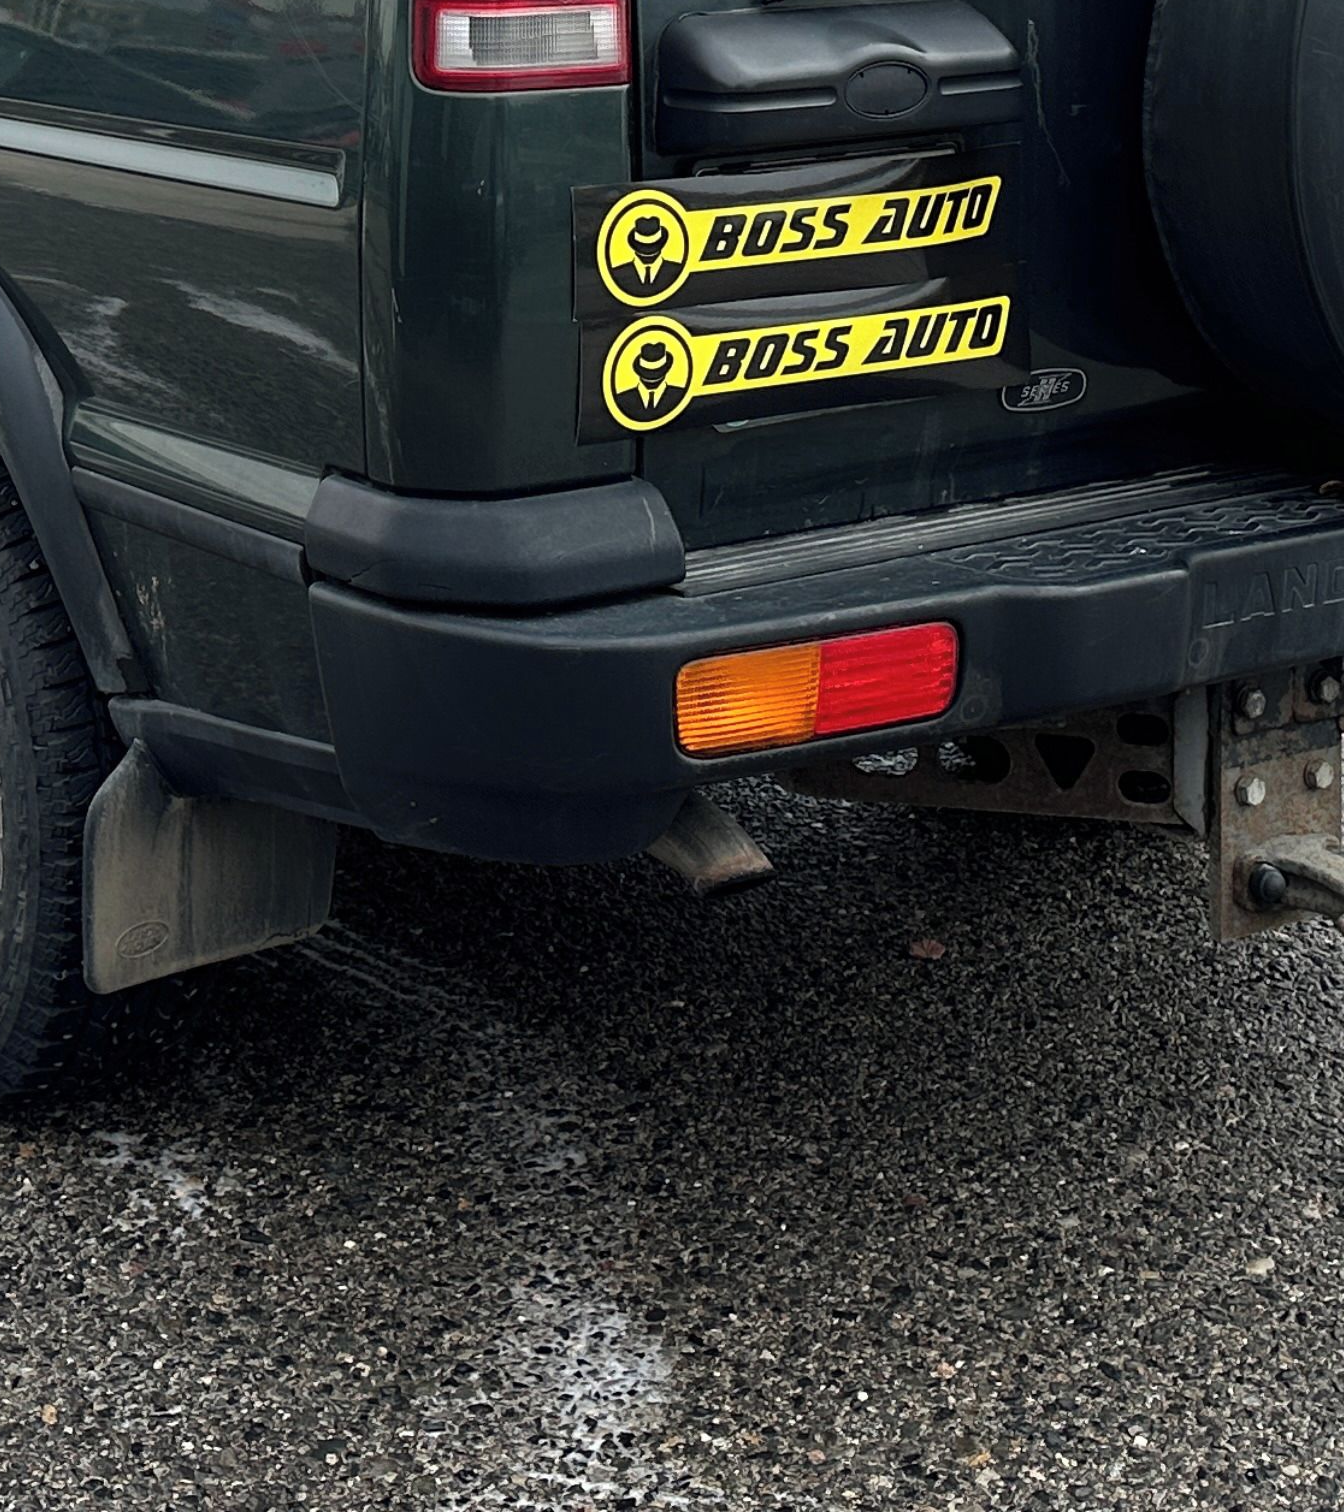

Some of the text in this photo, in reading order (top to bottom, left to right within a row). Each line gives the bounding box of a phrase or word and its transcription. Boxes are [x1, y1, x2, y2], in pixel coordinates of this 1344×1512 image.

[699, 183, 994, 263] BOSS AUTO
[703, 303, 1005, 387] BOSS AUTO
